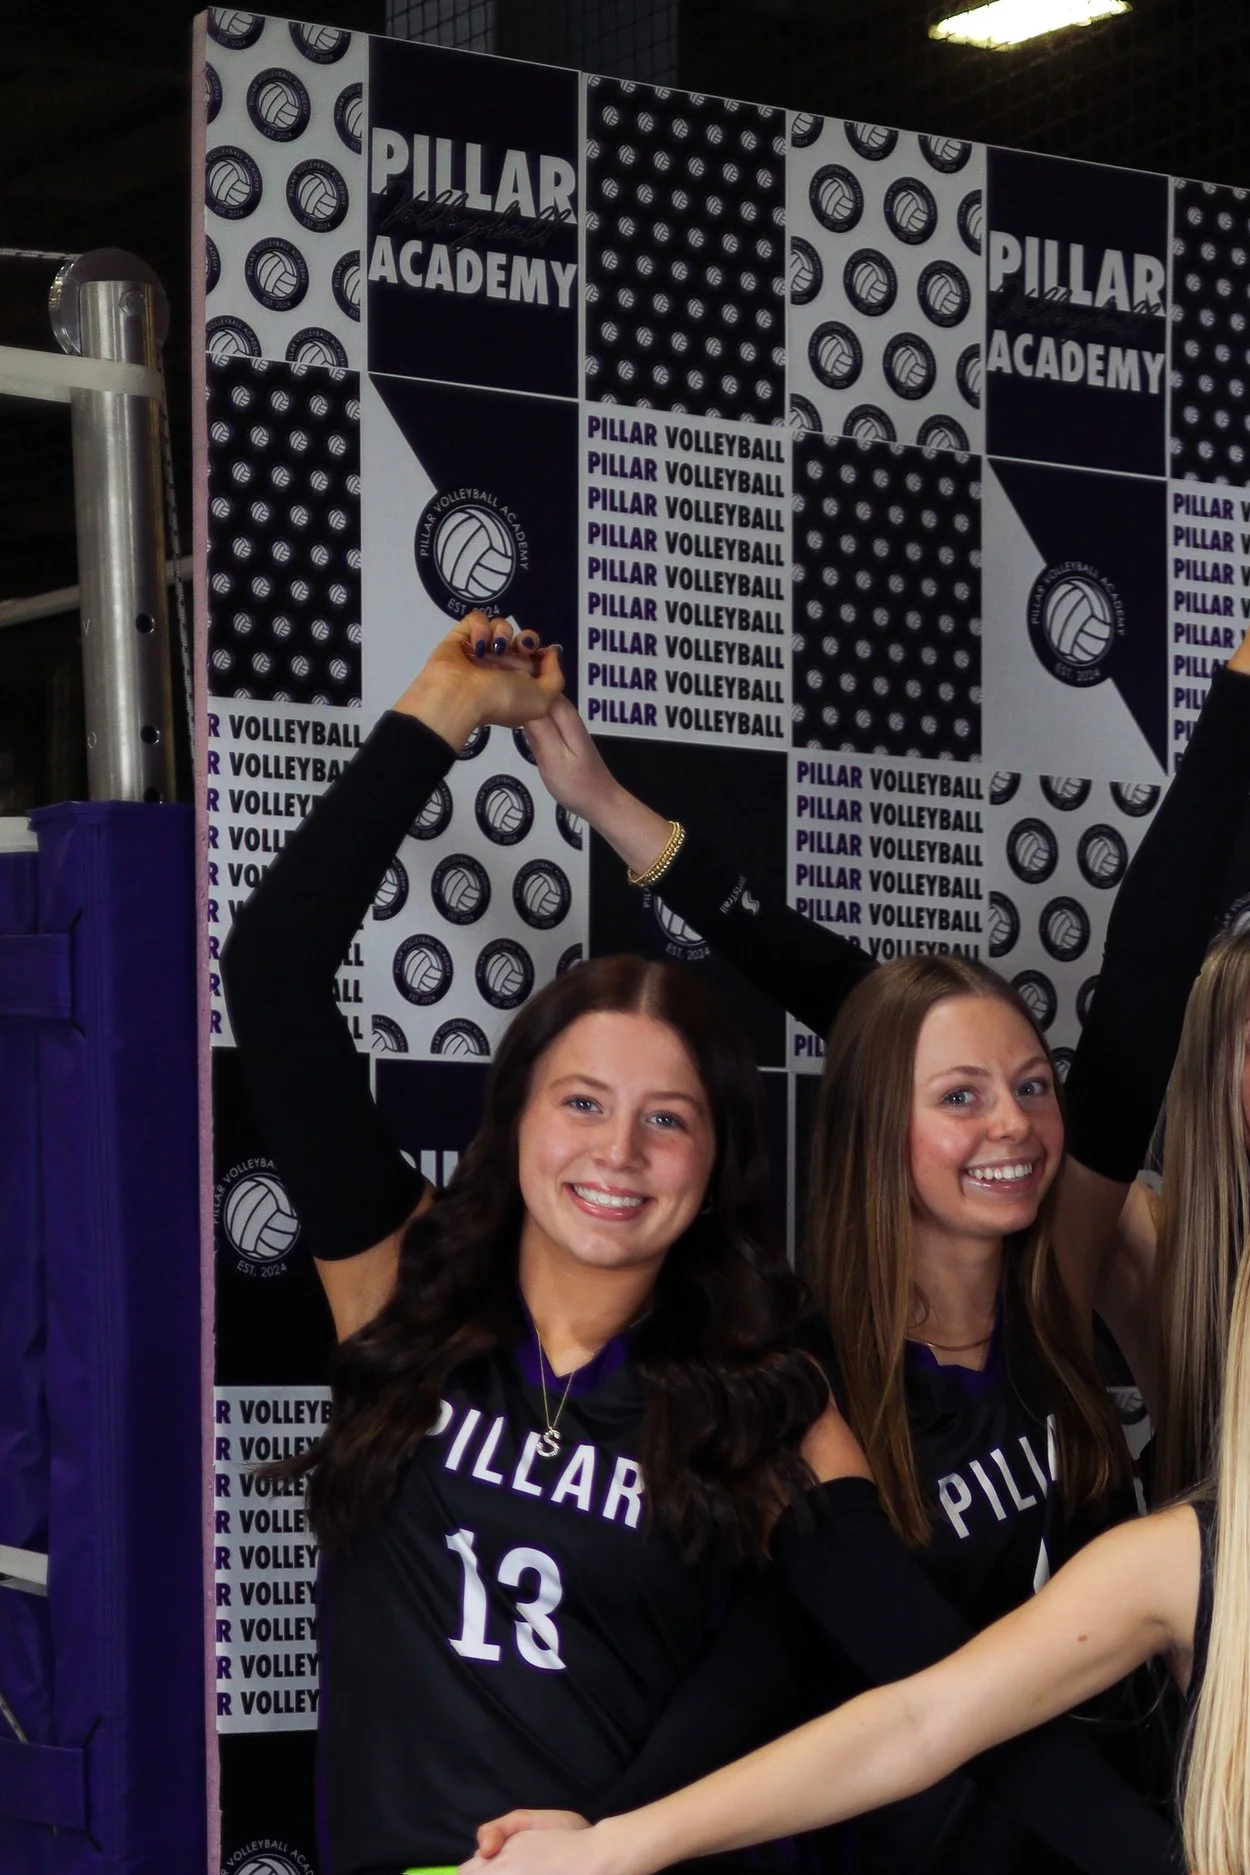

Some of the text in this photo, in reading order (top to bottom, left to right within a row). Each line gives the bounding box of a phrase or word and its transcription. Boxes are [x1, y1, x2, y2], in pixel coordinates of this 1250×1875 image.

[372, 126, 578, 224] PILLAR
[368, 235, 578, 308] ACADEMY
[989, 230, 1167, 317] PILLAR
[986, 329, 1166, 394] ACADEMY
[588, 416, 784, 463] PILLAR VOLLEYBALL
[588, 451, 784, 497] PILLAR VOLLEYBALL
[588, 486, 784, 532] PILLAR VOLLEYBALL
[1173, 493, 1234, 520] PILLAR
[420, 488, 529, 570] PILLAR VOLLEYBALL ACADEMY
[588, 521, 784, 566] PILLAR VOLLEYBALL
[1173, 526, 1234, 552] PILLAR
[588, 557, 784, 600] PILLAR VOLLEYBALL
[1173, 558, 1234, 584] PILLAR
[588, 592, 784, 635] PILLAR VOLLEYBALL
[1173, 590, 1234, 616] PILLAR
[588, 627, 784, 669] PILLAR VOLLEYBALL
[1173, 623, 1234, 648] PILLAR
[588, 663, 783, 704] PILLAR VOLLEYBALL
[229, 714, 362, 748] VOLLEYBALL
[588, 698, 783, 738] PILLAR VOLLEYBALL
[797, 761, 983, 800] PILLAR VOLLEYBALL
[797, 795, 983, 833] PILLAR VOLLEYBALL
[796, 829, 983, 866] PILLAR VOLLEYBALL
[796, 863, 982, 899] PILLAR VOLLEYBALL
[869, 903, 982, 932] VOLLEYBALL
[445, 1528, 566, 1670] 13
[226, 1839, 288, 1867] VOLLEYBALL
